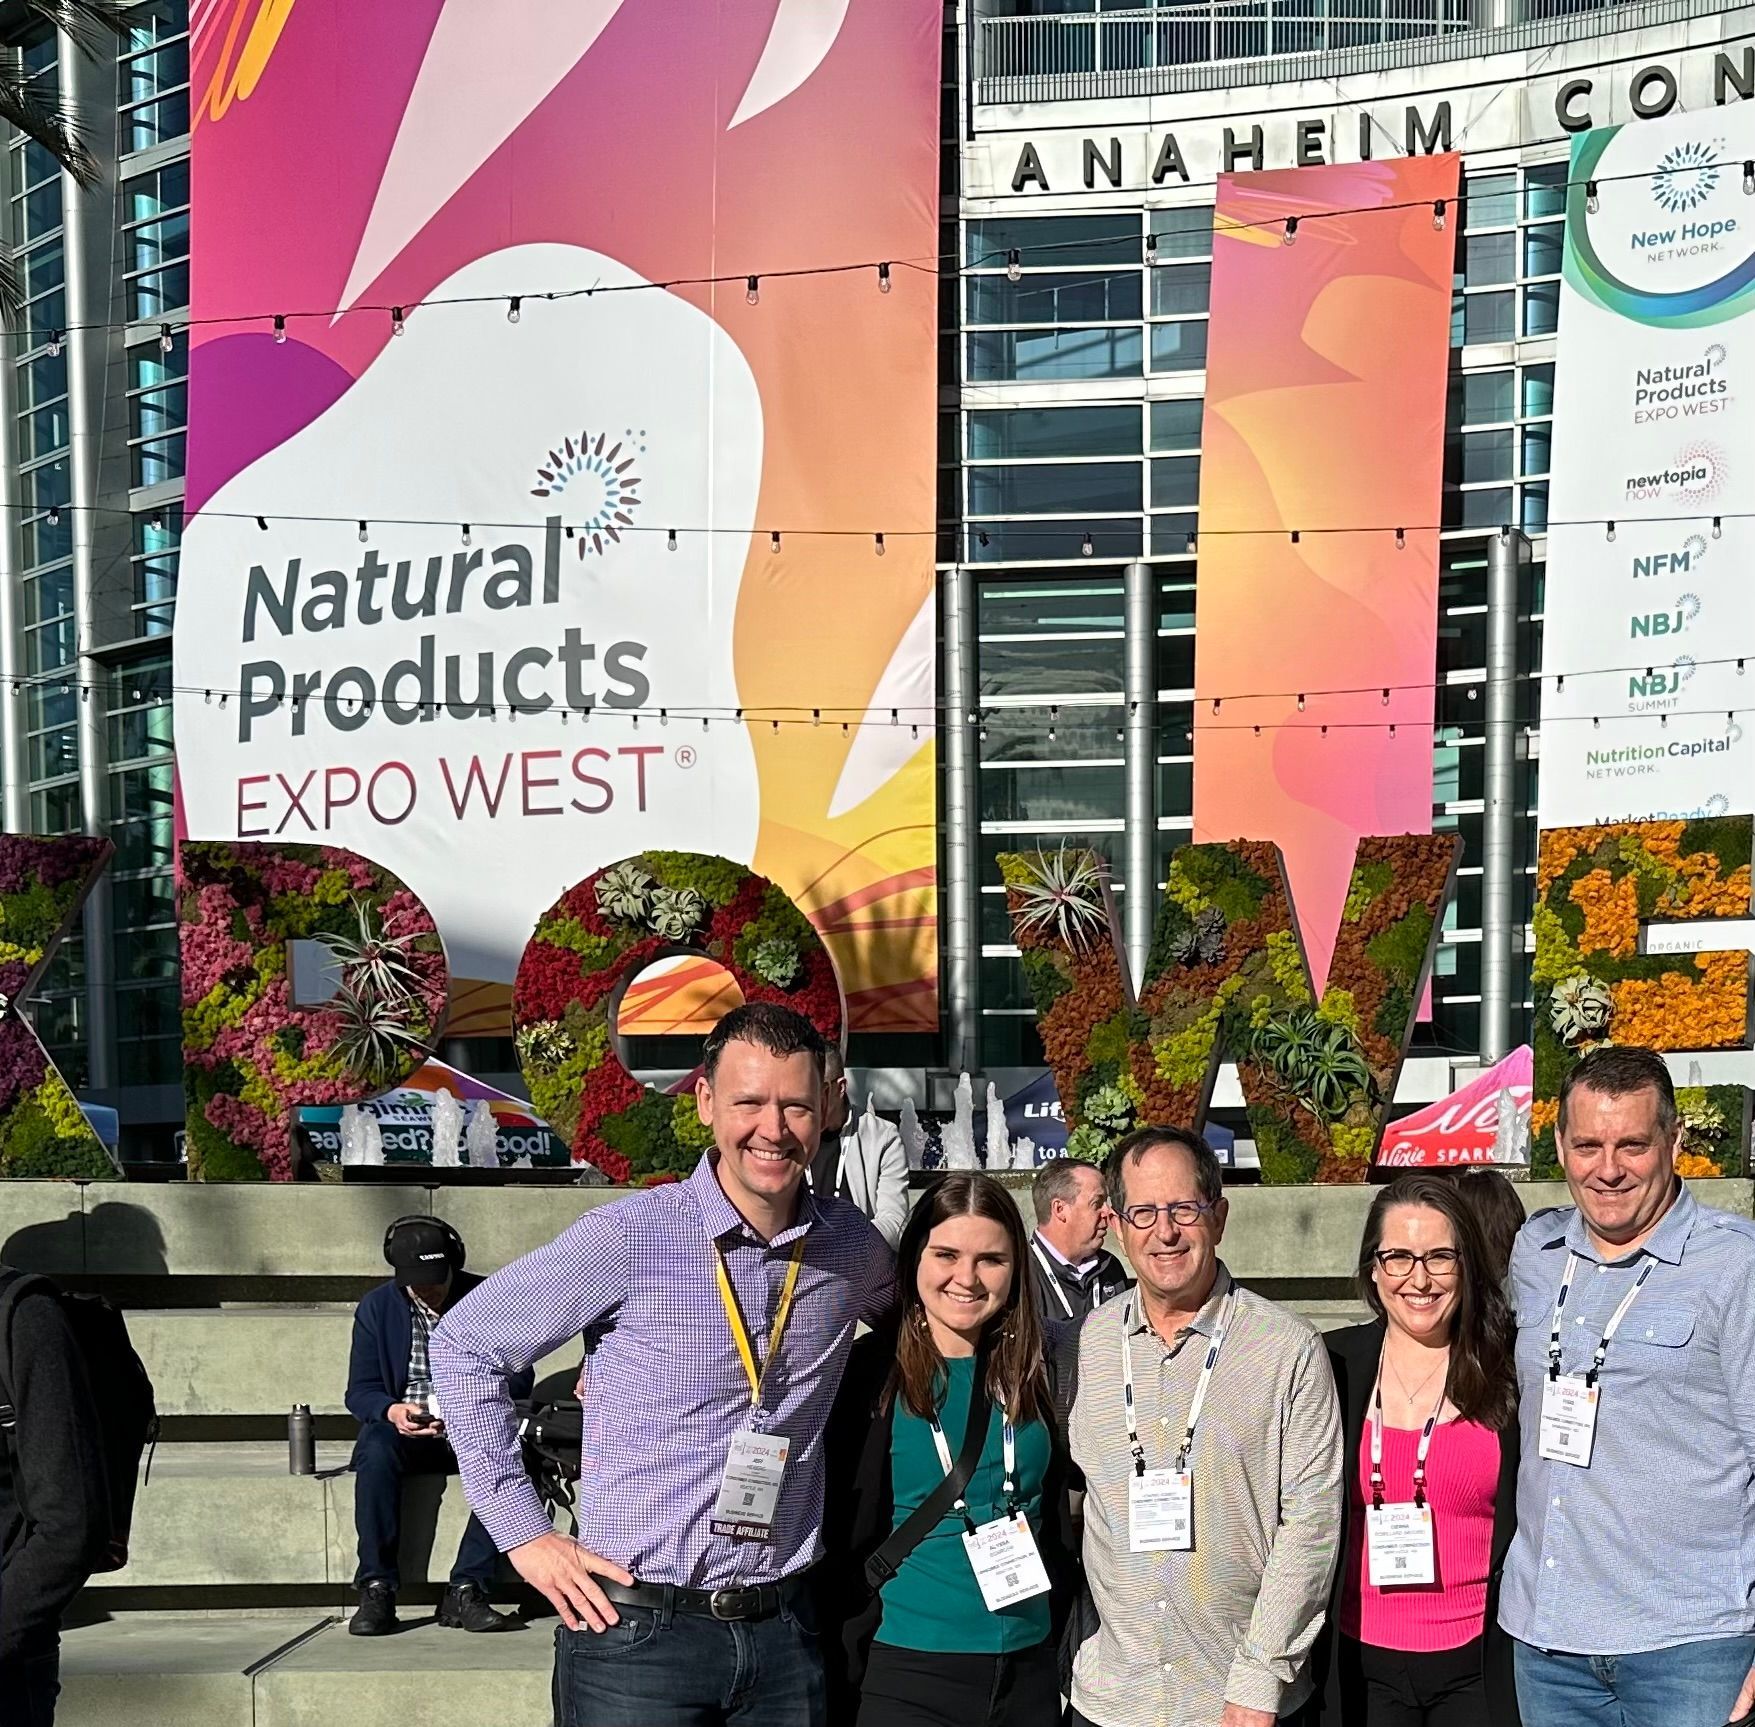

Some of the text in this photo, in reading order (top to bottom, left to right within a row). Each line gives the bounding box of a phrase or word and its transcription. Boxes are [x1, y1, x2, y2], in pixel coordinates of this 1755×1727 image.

[1011, 100, 1453, 191] ANAHEIM
[1631, 217, 1737, 250] New Hope
[1647, 243, 1719, 264] NETWORK
[1636, 358, 1712, 387] Natural
[1635, 378, 1728, 406] Products
[1634, 399, 1728, 424] EXPO WEST
[1626, 465, 1707, 490] newtopia
[1625, 487, 1661, 501] now
[1632, 551, 1690, 578] NFM
[242, 515, 562, 642] Natural
[1630, 610, 1683, 638] NBJ
[238, 627, 650, 743] Products
[1628, 672, 1680, 698] NBJ
[1628, 698, 1679, 712] SUMMIT
[1586, 736, 1730, 765] Nutrition Capital
[1586, 764, 1655, 779] NETWORK
[237, 761, 417, 838] EXPO
[1649, 940, 1704, 953] ORGANIC
[1024, 1101, 1066, 1119] Lif
[1038, 1146, 1057, 1160] to
[1437, 1148, 1499, 1162] SPARK
[713, 1522, 770, 1539] TRADE AFFILIATE
